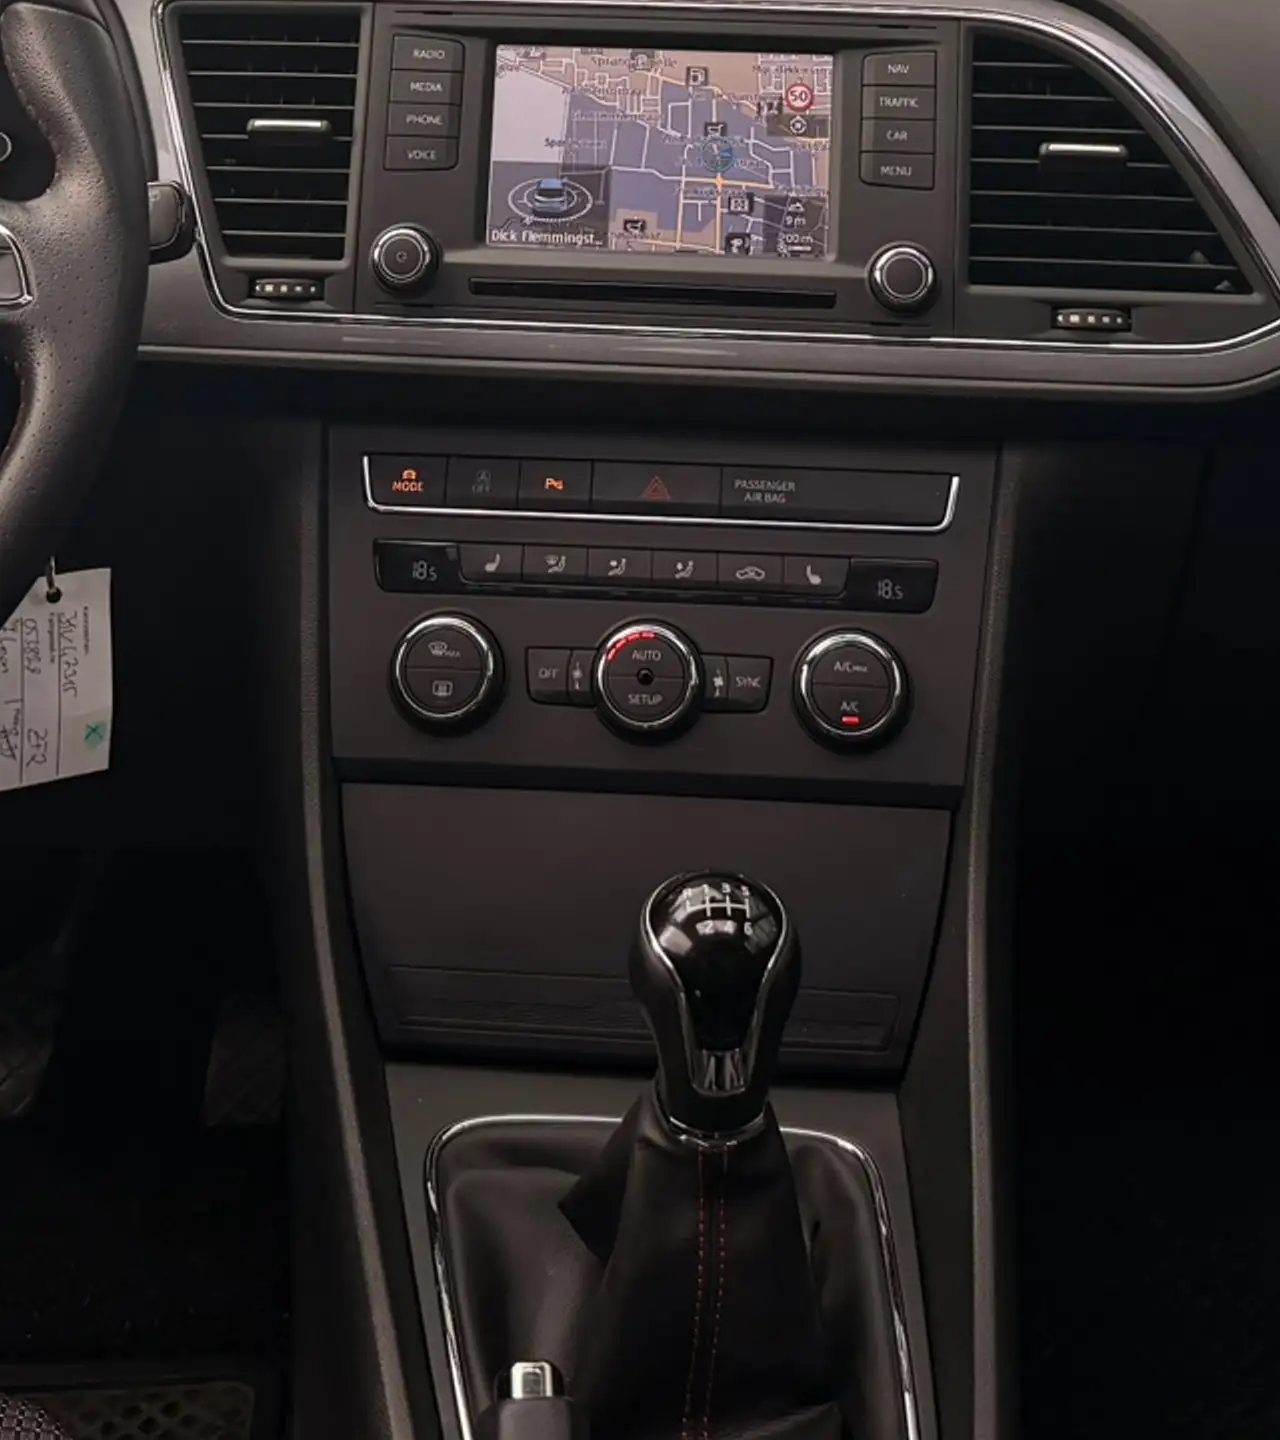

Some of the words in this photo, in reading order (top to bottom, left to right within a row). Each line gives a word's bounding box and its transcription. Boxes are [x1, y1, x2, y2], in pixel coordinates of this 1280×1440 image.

[412, 48, 446, 60] RADIO
[887, 63, 910, 75] NAV
[409, 80, 443, 92] MEDIA
[789, 90, 809, 103] 50
[879, 95, 919, 108] TRAFFIC
[405, 112, 443, 126] PHONE
[885, 129, 909, 141] CAR
[407, 148, 437, 161] VOICE
[879, 165, 913, 177] MENU
[491, 228, 518, 243] Dick
[391, 480, 425, 493] MODE
[733, 478, 797, 493] PASSENGER
[631, 649, 663, 662] AUTO
[537, 666, 561, 680] OFF
[735, 675, 762, 690] SYNC
[627, 692, 665, 706] SETUP
